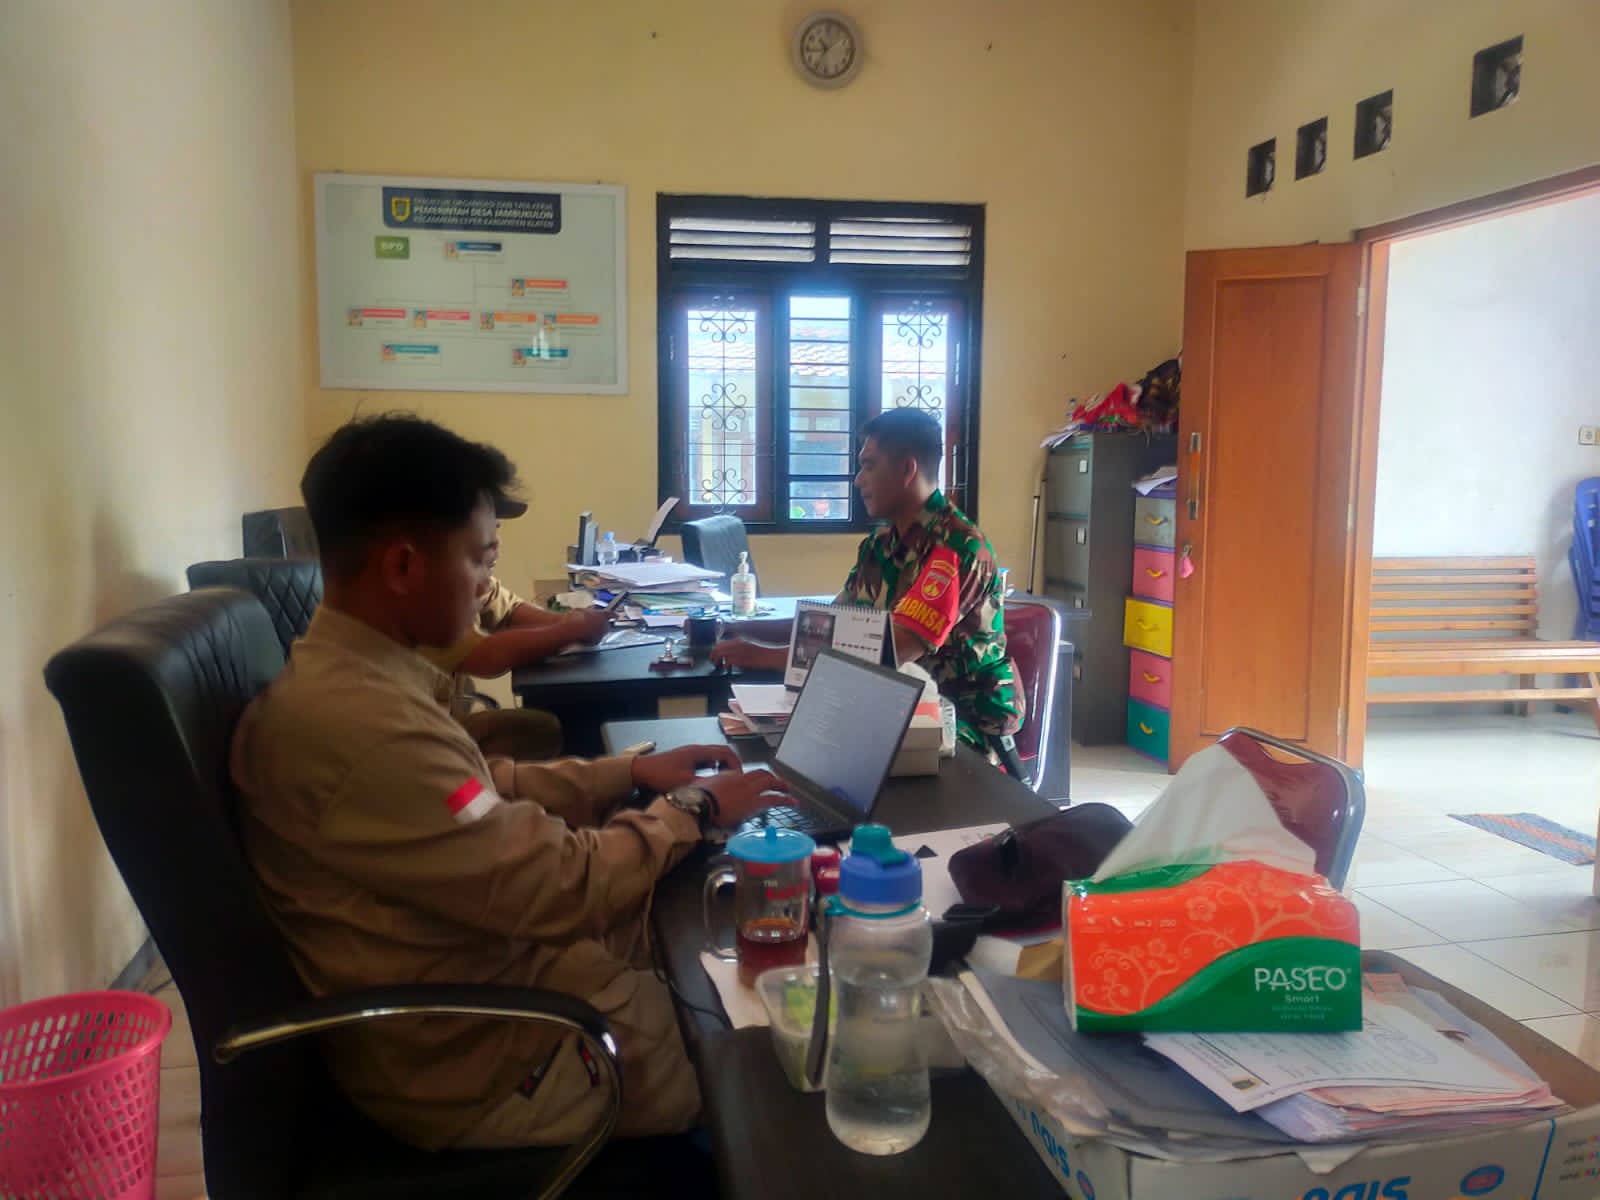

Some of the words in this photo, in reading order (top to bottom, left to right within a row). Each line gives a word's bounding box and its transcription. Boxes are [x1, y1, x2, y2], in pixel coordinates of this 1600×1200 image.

[414, 207, 468, 216] PEMERINTAH
[471, 208, 493, 216] DESA
[1254, 965, 1347, 992] PASEO
[1284, 994, 1320, 1003] Smart
